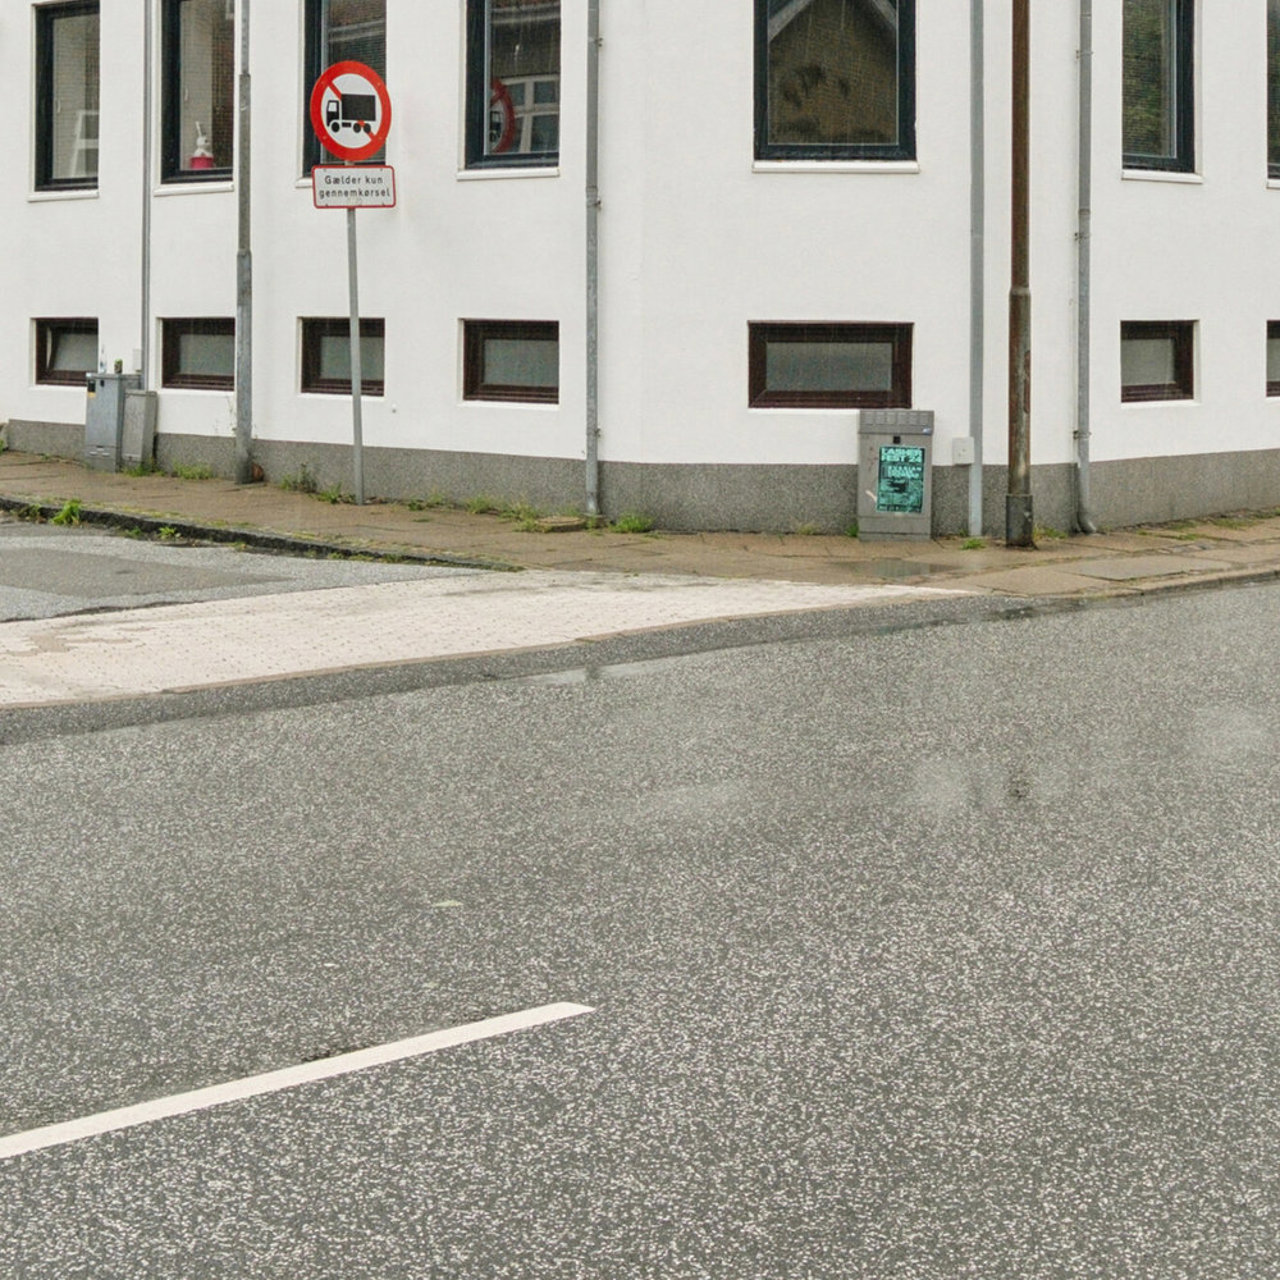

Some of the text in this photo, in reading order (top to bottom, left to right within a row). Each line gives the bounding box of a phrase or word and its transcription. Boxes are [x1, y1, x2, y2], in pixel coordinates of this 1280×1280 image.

[324, 175, 384, 184] Gælder kun
[319, 188, 391, 199] gennemkørsel
